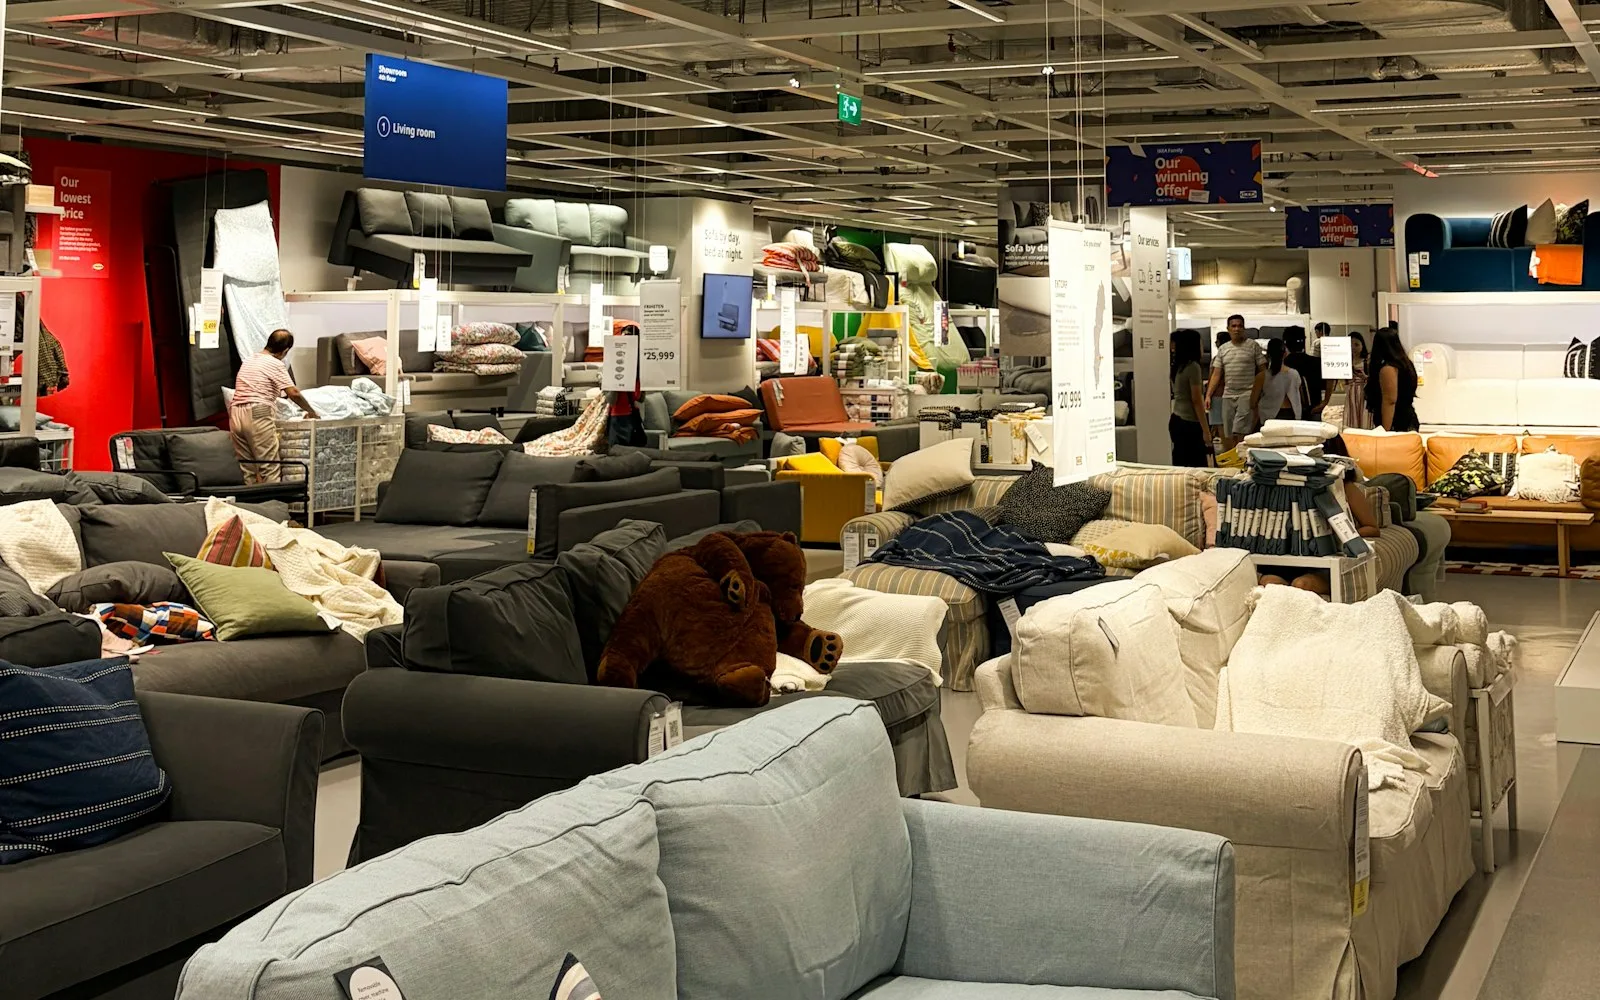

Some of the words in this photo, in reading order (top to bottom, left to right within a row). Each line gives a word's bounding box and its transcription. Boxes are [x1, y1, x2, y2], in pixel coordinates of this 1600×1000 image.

[378, 65, 407, 77] Showroom
[392, 123, 415, 139] Living
[416, 128, 435, 138] room
[1155, 157, 1181, 169] Our
[60, 176, 79, 187] Our
[1155, 169, 1209, 184] winning
[1155, 184, 1188, 197] offer
[60, 191, 91, 204] lowest
[60, 207, 84, 221] price
[1319, 215, 1338, 223] Our
[1319, 224, 1359, 234] winning
[705, 228, 719, 240] Sofa
[719, 230, 727, 244] by
[728, 231, 741, 246] day,
[1145, 236, 1160, 247] services
[1320, 233, 1345, 243] offer
[704, 244, 716, 257] bed
[717, 248, 724, 258] at
[725, 247, 743, 262] night.
[1005, 244, 1024, 252] Sofa
[1025, 244, 1036, 254] by
[1037, 244, 1049, 252] da
